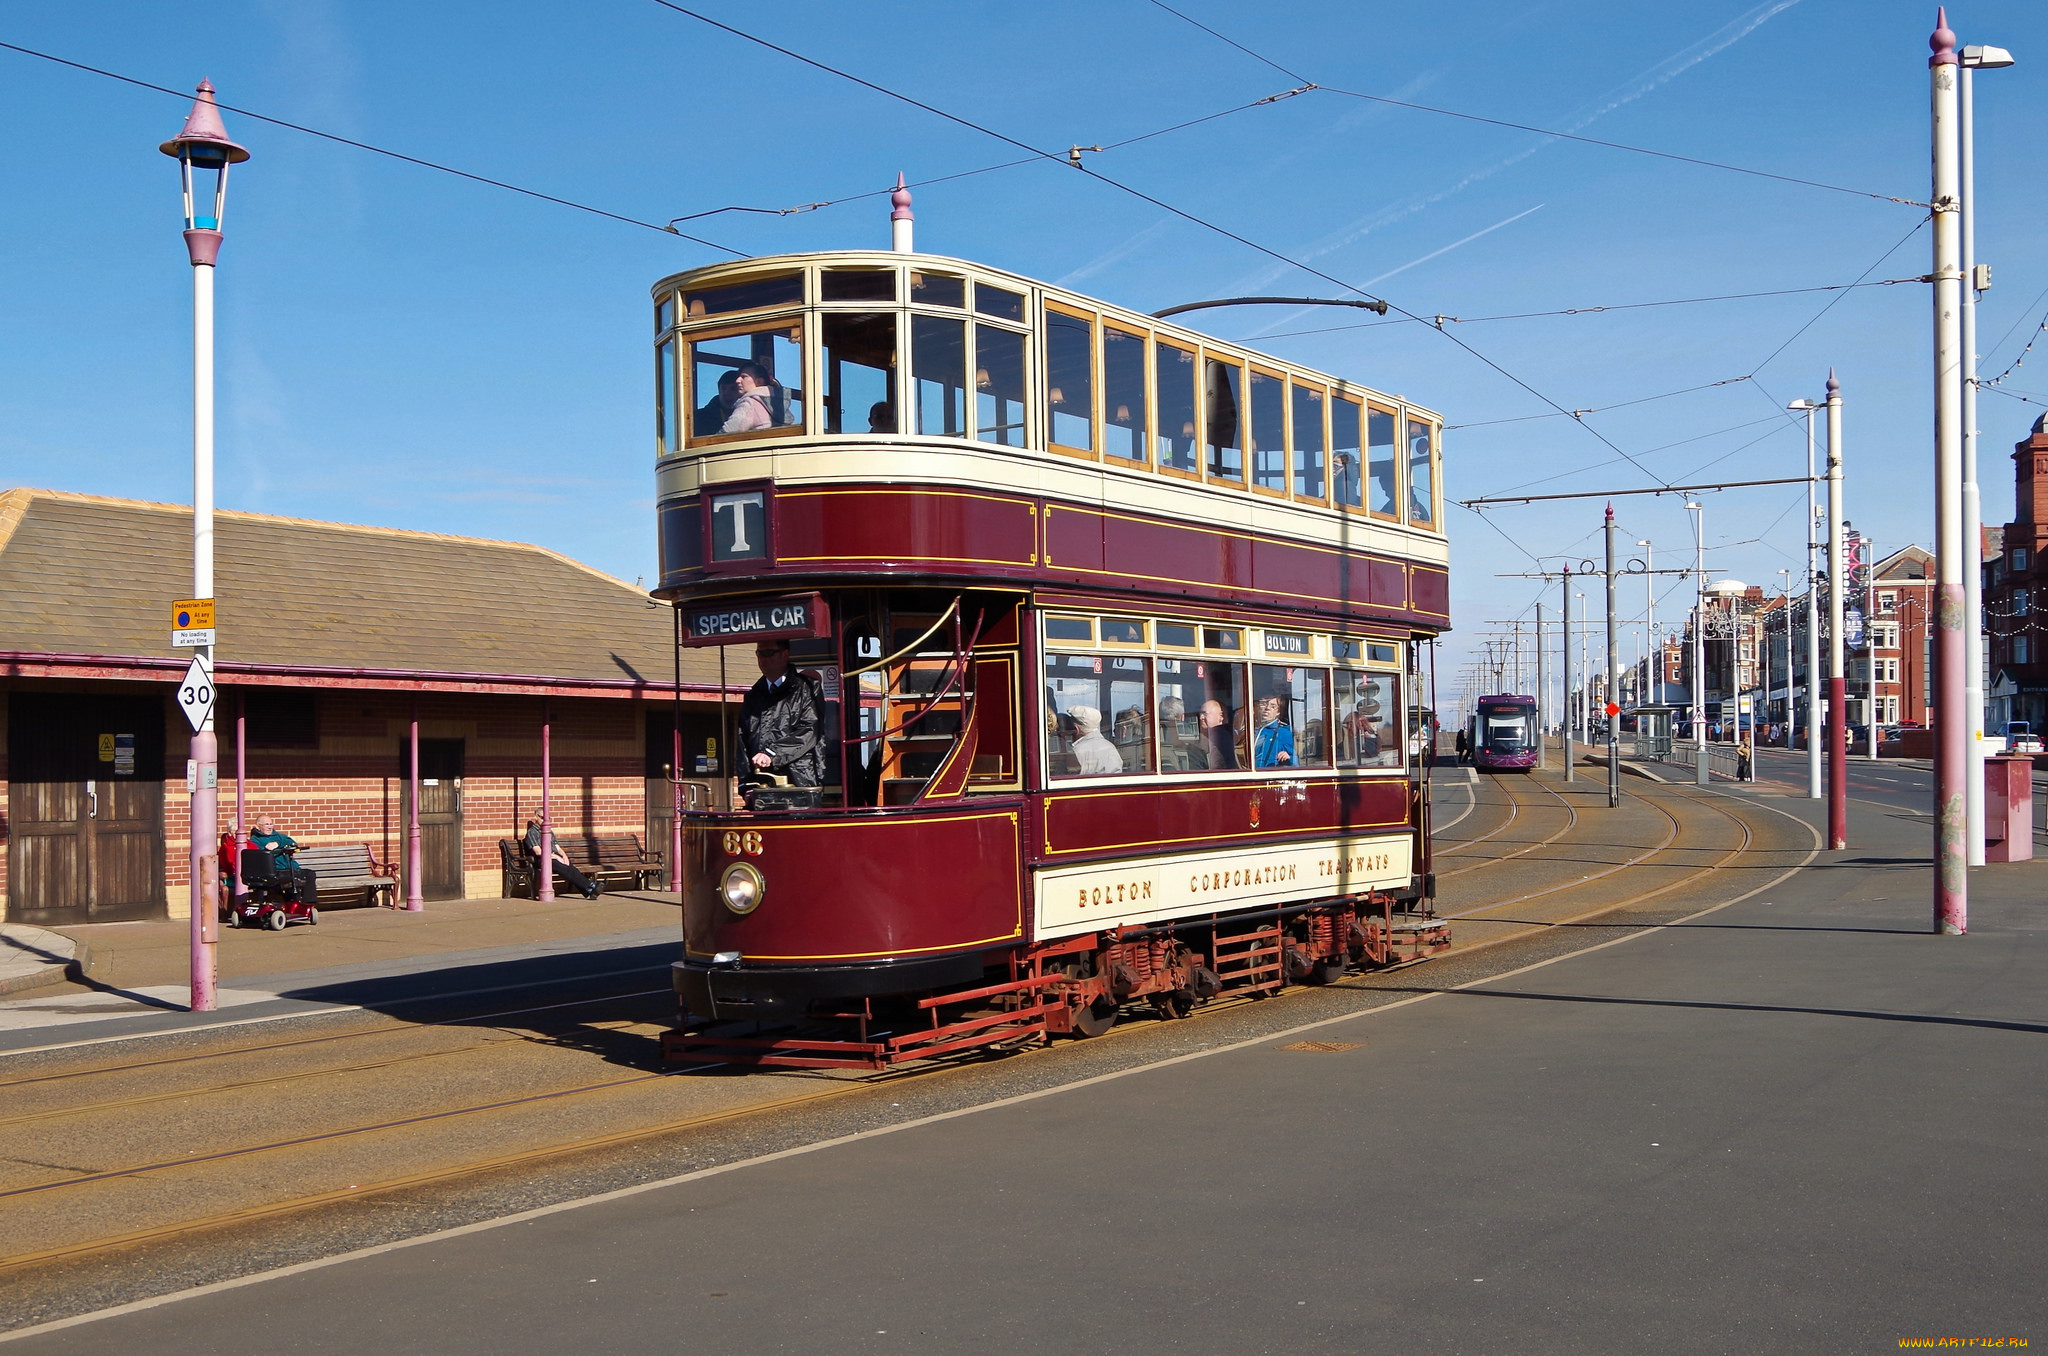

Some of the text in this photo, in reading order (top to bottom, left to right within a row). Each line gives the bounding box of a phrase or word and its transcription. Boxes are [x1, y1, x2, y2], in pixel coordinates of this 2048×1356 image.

[713, 498, 764, 552] T
[699, 606, 805, 635] SPECIAL CAR
[1266, 635, 1301, 651] BOLTON
[183, 686, 210, 705] 30
[723, 830, 764, 856] 66
[1079, 854, 1389, 908] BOLTON CORPORATION TRAMWAYS
